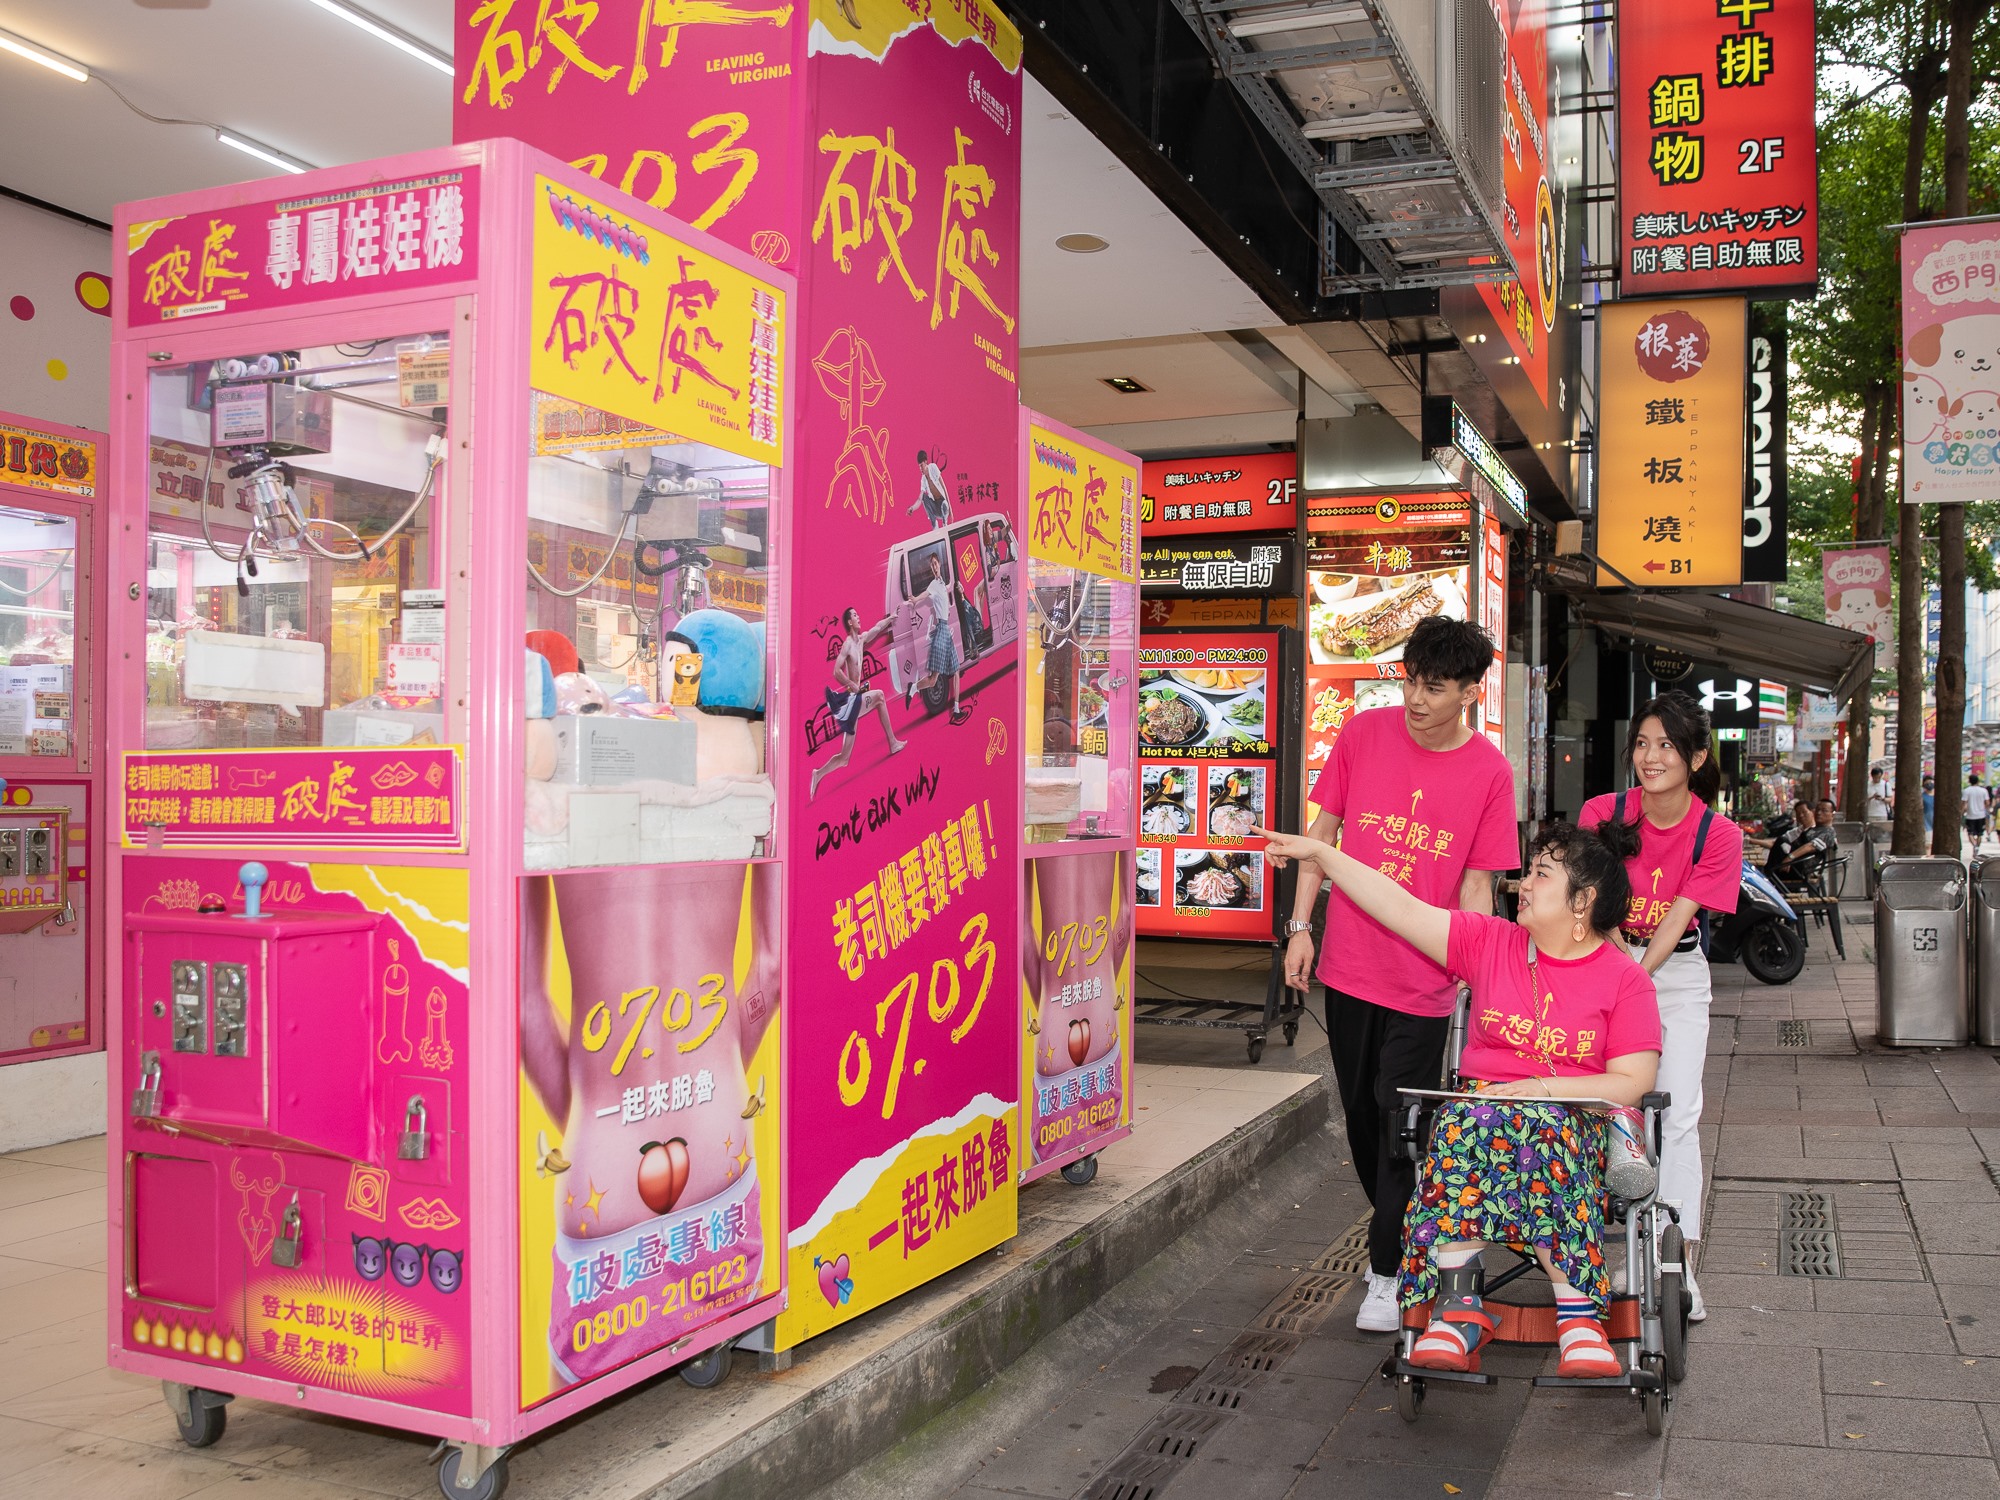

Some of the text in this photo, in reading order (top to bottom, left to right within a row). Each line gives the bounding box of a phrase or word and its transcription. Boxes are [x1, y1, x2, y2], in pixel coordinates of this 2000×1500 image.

[706, 51, 766, 74] LEAVING
[728, 63, 793, 85] VIRGINIA
[1651, 75, 1702, 184] 鍋物
[1739, 137, 1785, 174] 2F
[812, 125, 1016, 335] 破處
[1634, 207, 1804, 238] 美味しいキッチン
[265, 186, 465, 290] 專屬娃娃機
[144, 219, 249, 306] 破處
[1632, 239, 1802, 274] 附餐自助無限
[1932, 262, 2000, 296] 西門
[544, 255, 741, 404] 破處
[974, 332, 1003, 361] LEAVING
[748, 287, 779, 447] 專屬娃娃機
[985, 355, 1016, 385] VIRGINIA
[697, 398, 727, 416] LEAVING
[709, 414, 741, 433] VIRGINIA
[1164, 469, 1242, 487] 美味しいキッチン
[1642, 398, 1686, 544] 鐵板燒
[1688, 399, 1700, 543] TEPPANYAKI
[1934, 467, 1994, 475] Happy Happy
[80, 486, 92, 497] 12
[1267, 479, 1297, 505] 2F
[1034, 465, 1118, 562] 破處
[1164, 500, 1252, 521] 附餐自助無限
[1120, 476, 1134, 578] 專屬娃娃機
[1154, 549, 1170, 560] All
[1171, 550, 1190, 563] you
[1193, 550, 1212, 560] can
[1251, 546, 1281, 564] 附餐
[1364, 540, 1412, 573] 牛排
[1669, 559, 1693, 574] B1
[1182, 560, 1274, 590] 無限自助
[1836, 566, 1879, 581] 西門町
[1190, 608, 1290, 622] TEPPANAK
[1207, 647, 1268, 663] PM24:00
[1653, 660, 1682, 670] HOTEL
[389, 663, 397, 679] $
[1376, 663, 1402, 678] VS.
[1312, 686, 1356, 729] 火鍋
[1083, 729, 1107, 755] 鍋
[1142, 747, 1183, 757] Hot Pot
[1186, 748, 1229, 758] 샤브샤브
[1232, 741, 1269, 753] なべ物
[280, 760, 367, 823] 破處
[867, 790, 902, 833] ask
[904, 763, 941, 803] why
[370, 796, 451, 825] 電影票及電影T恤
[1142, 833, 1177, 844] NT.340
[1207, 835, 1244, 845] NT.370
[1175, 906, 1211, 917] NT.360
[1045, 914, 1109, 977] 07.03
[748, 998, 761, 1011] 18+
[1050, 976, 1103, 1009] 一起來脫魯
[581, 972, 729, 1077] 07.03
[749, 1005, 766, 1023] MAYBE
[837, 912, 998, 1120] 07.03
[595, 1068, 717, 1127] 一起來脫魯
[1038, 1063, 1116, 1119] 破處專線
[1040, 1097, 1116, 1148] 0800-216123
[867, 1118, 1013, 1261] 一起來脫魯
[567, 1201, 748, 1308] 破處專線
[572, 1255, 748, 1353] 0800-216123
[261, 1293, 444, 1352] 登大郎以後的世界
